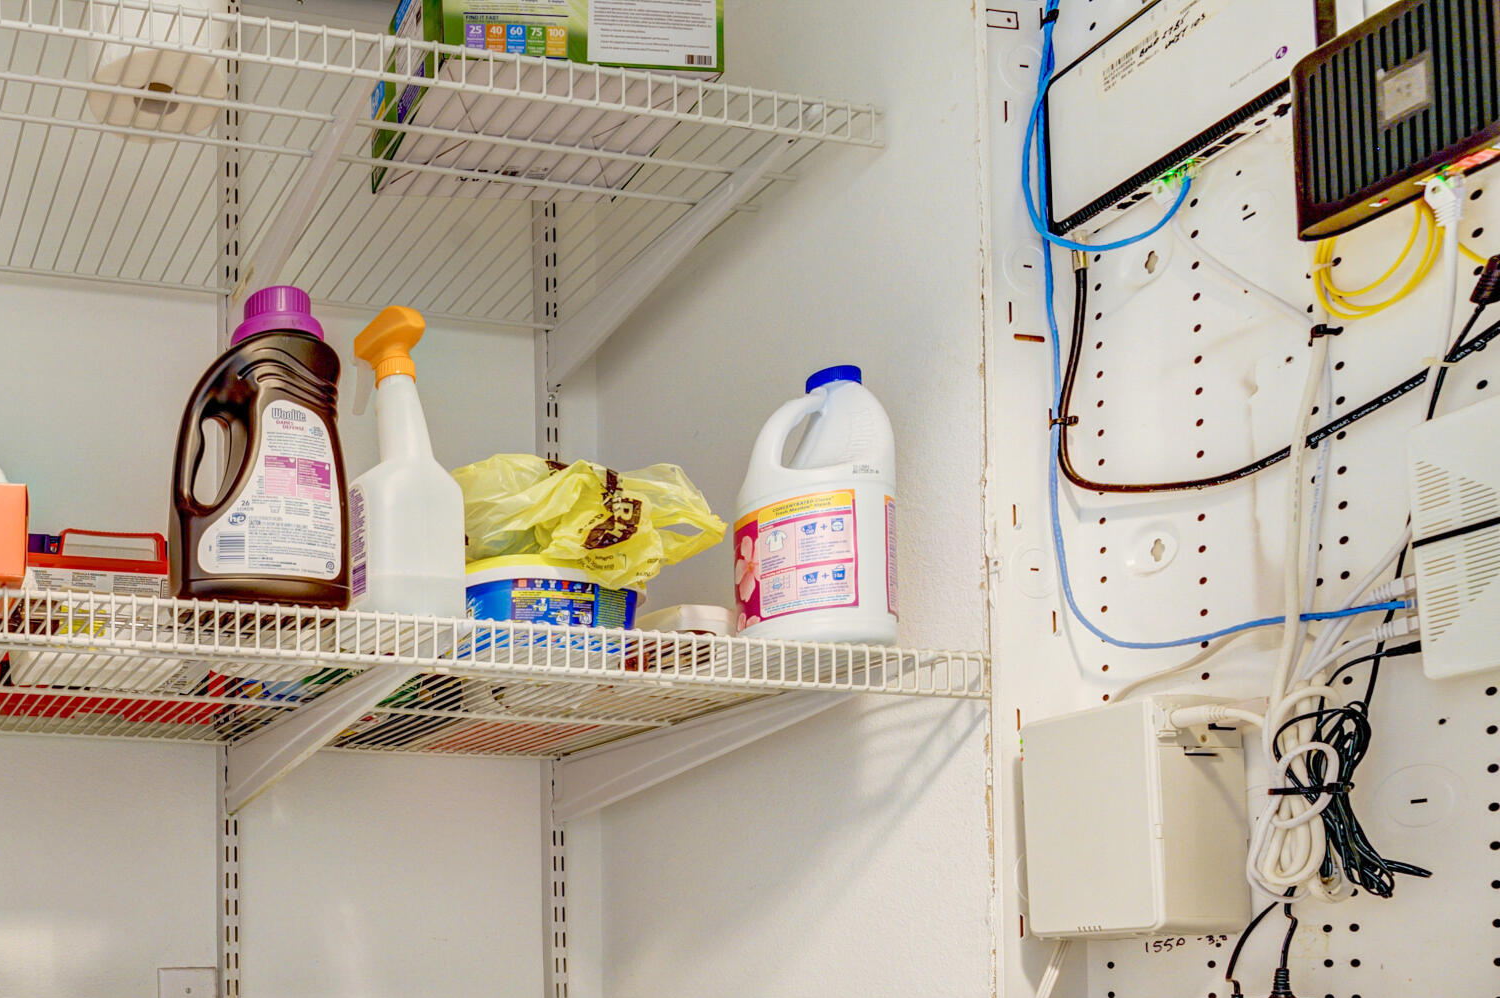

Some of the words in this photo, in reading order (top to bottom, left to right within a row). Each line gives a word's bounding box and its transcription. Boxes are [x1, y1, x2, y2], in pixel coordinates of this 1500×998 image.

[469, 25, 482, 34] 25
[489, 25, 503, 34] 40
[509, 26, 523, 36] 60
[531, 28, 543, 37] 75
[547, 29, 565, 38] 100
[271, 407, 307, 422] Woolite
